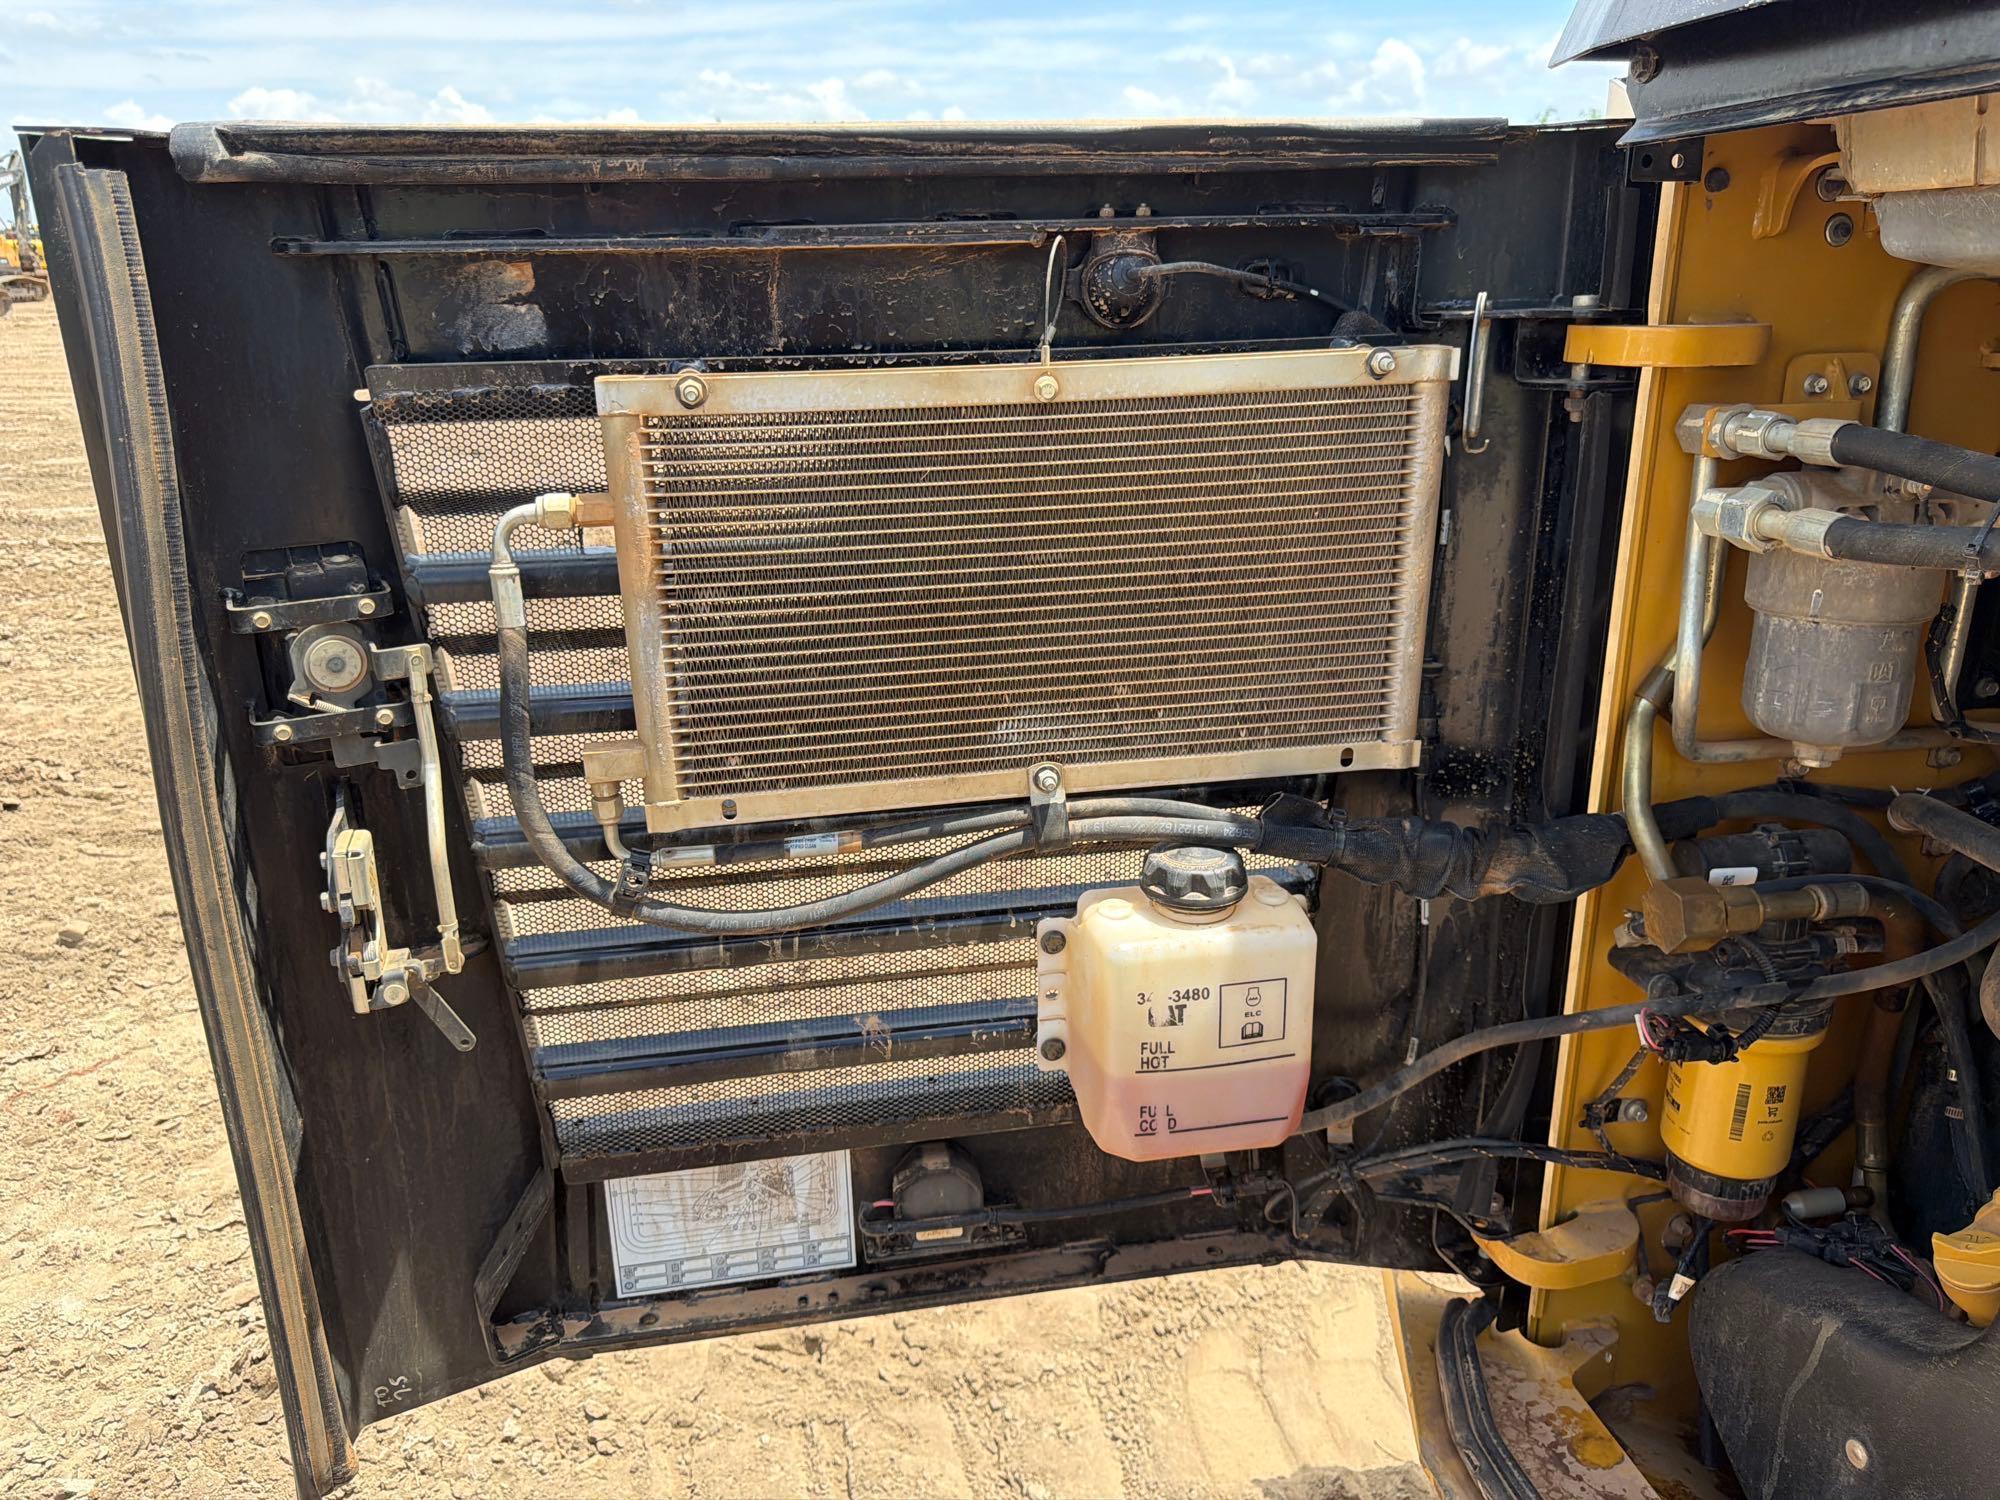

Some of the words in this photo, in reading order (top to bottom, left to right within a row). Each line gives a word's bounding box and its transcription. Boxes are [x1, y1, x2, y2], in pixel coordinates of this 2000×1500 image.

[1137, 987, 1210, 1005] 3-3480
[1245, 1009, 1262, 1018] ELC
[1140, 1041, 1175, 1055] FULL
[1141, 1055, 1170, 1070] HOT
[1139, 1104, 1174, 1119] FUL
[1139, 1117, 1177, 1132] COD
